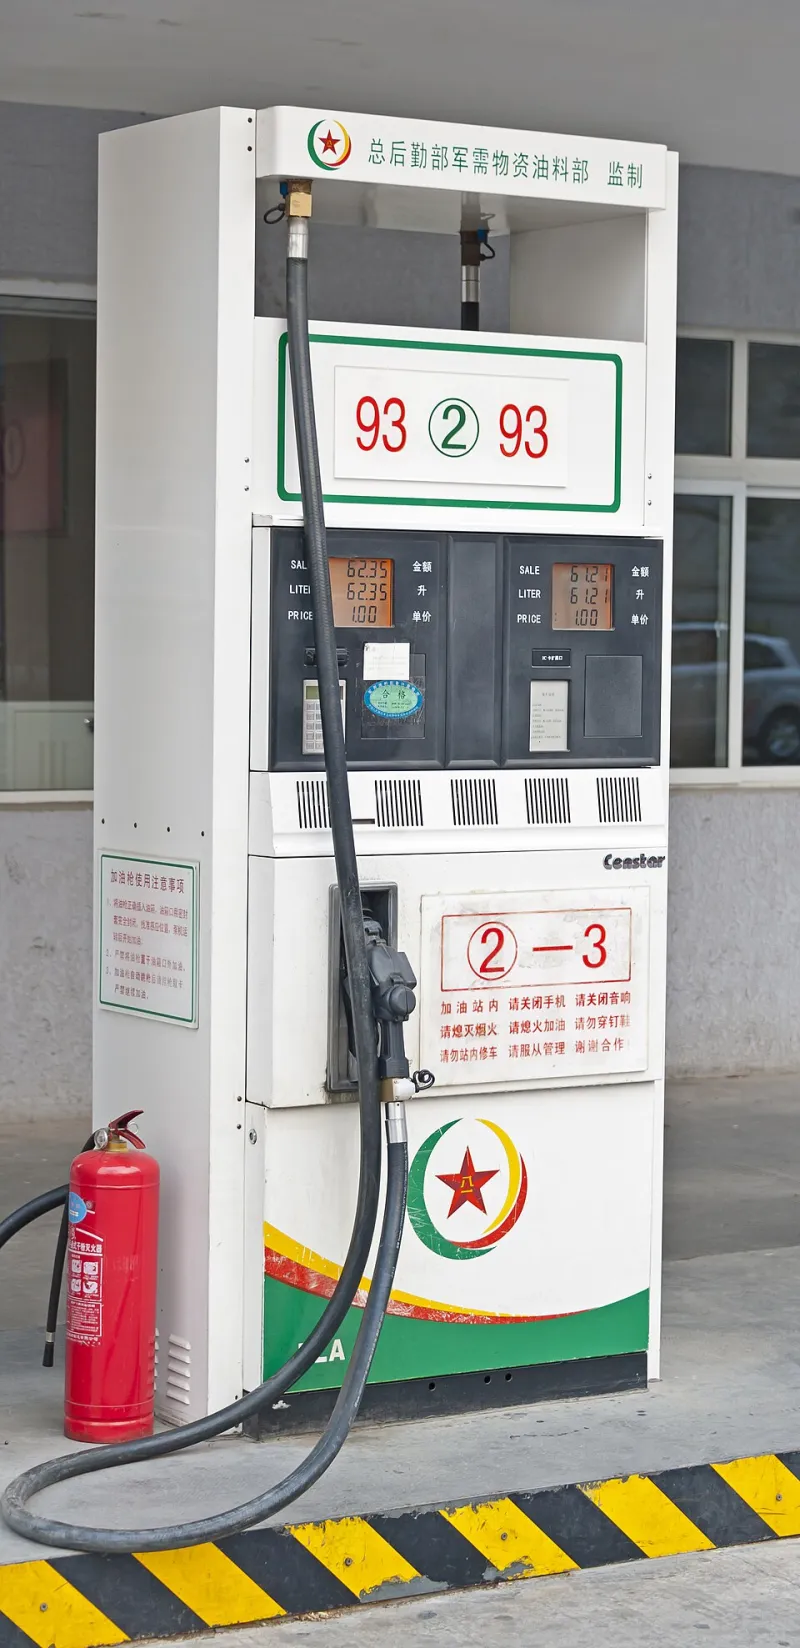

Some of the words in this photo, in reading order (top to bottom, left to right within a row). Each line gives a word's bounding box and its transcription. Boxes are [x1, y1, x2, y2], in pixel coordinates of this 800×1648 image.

[368, 138, 589, 184] 总后勤部军需物资油料部
[607, 161, 643, 189] 监制
[356, 396, 407, 452] 93
[499, 404, 549, 458] 93
[290, 560, 308, 570] SAL
[347, 560, 387, 578] 62.35
[519, 566, 540, 575] SALE
[346, 582, 387, 600] 62.35
[416, 585, 427, 596] 升
[518, 589, 541, 599] LITER
[635, 590, 645, 600] 升
[288, 611, 313, 620] PRICE
[352, 606, 377, 623] 1.00
[412, 610, 432, 623] 单价
[517, 614, 541, 624] PRICE
[575, 609, 598, 627] 1.00
[631, 614, 649, 625] 单价
[603, 853, 666, 870] Censtar
[110, 870, 184, 893] 加油枪使用注意事项
[440, 998, 499, 1015] 加油站内
[508, 994, 566, 1011] 请关闭手机
[575, 991, 631, 1007] 请关闭音响
[440, 1022, 497, 1039] 请熄灭烟火
[508, 1018, 566, 1034] 请熄火加油
[575, 1014, 631, 1030] 请勿穿钉鞋
[440, 1046, 498, 1063] 请勿站内修车
[508, 1041, 566, 1058] 请服从管理
